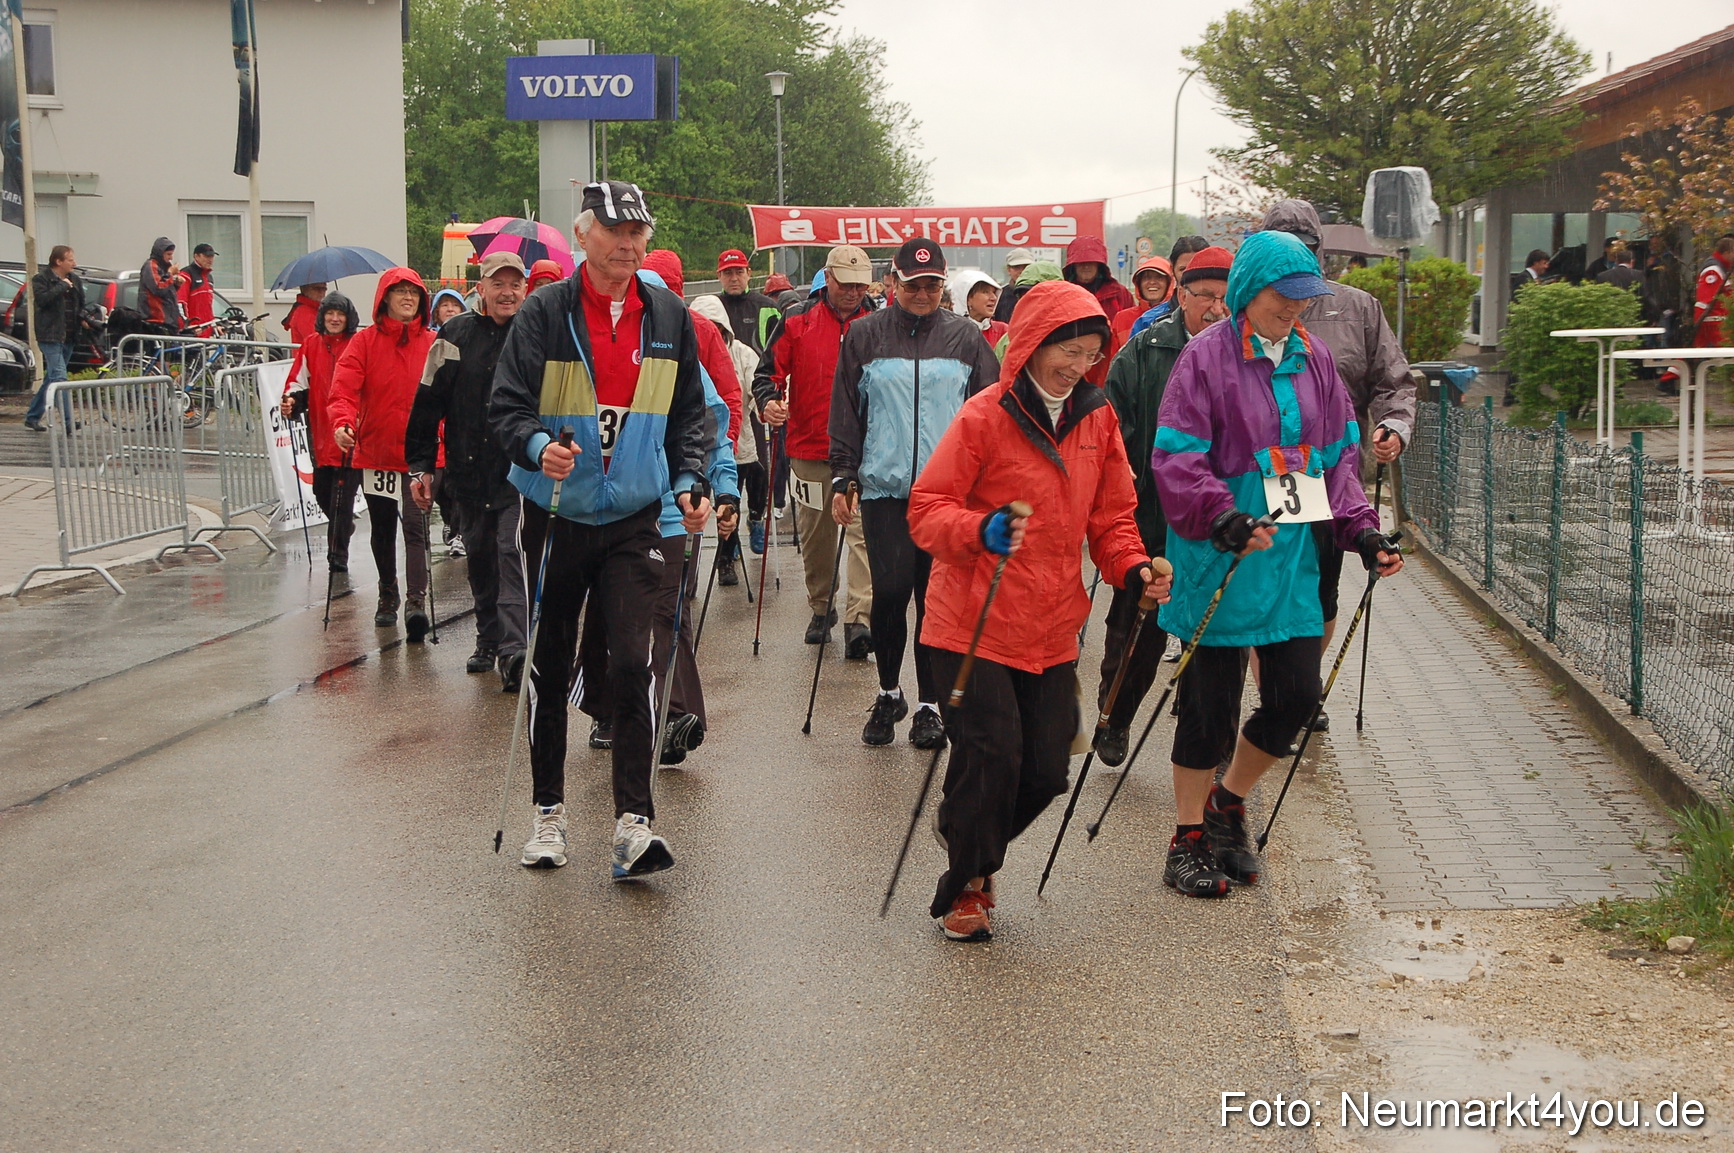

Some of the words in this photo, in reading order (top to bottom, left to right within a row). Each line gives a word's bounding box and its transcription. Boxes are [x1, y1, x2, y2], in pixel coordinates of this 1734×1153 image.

[519, 74, 635, 98] VOLVO
[373, 470, 397, 494] 38
[795, 479, 810, 504] 41
[1279, 473, 1302, 516] 3
